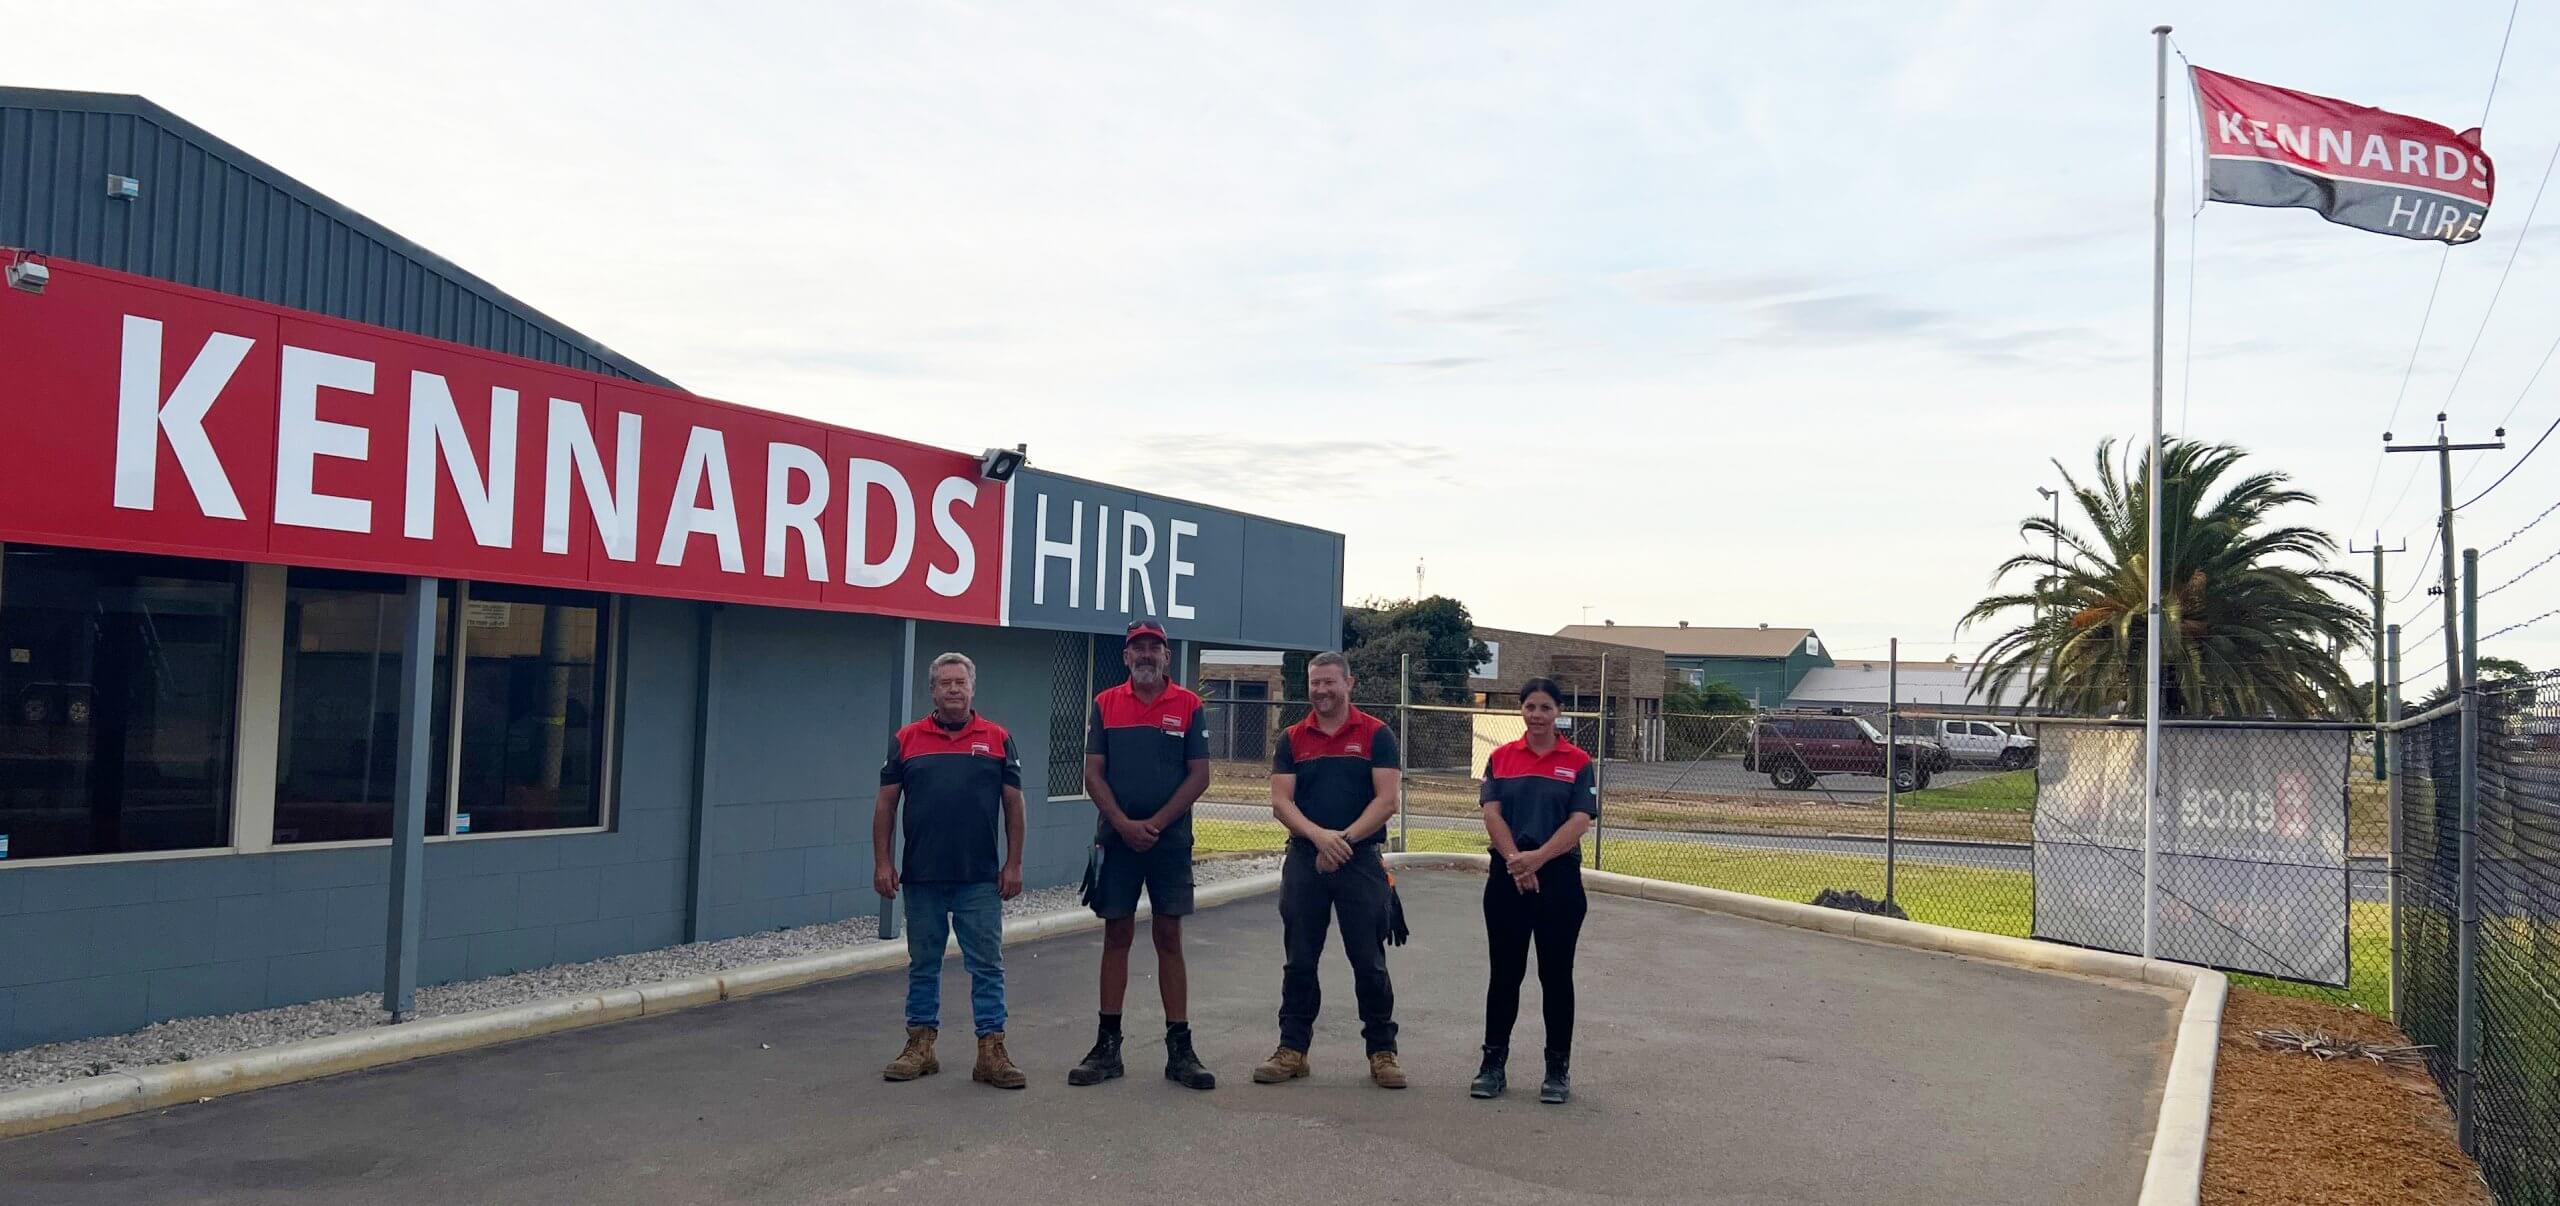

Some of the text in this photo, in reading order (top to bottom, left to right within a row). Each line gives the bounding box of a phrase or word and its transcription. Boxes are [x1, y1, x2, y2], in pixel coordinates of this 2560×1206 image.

[2217, 110, 2488, 190] KENNARDS
[2387, 195, 2483, 242] HIRE
[113, 314, 1199, 621] KENNARDS HIRE
